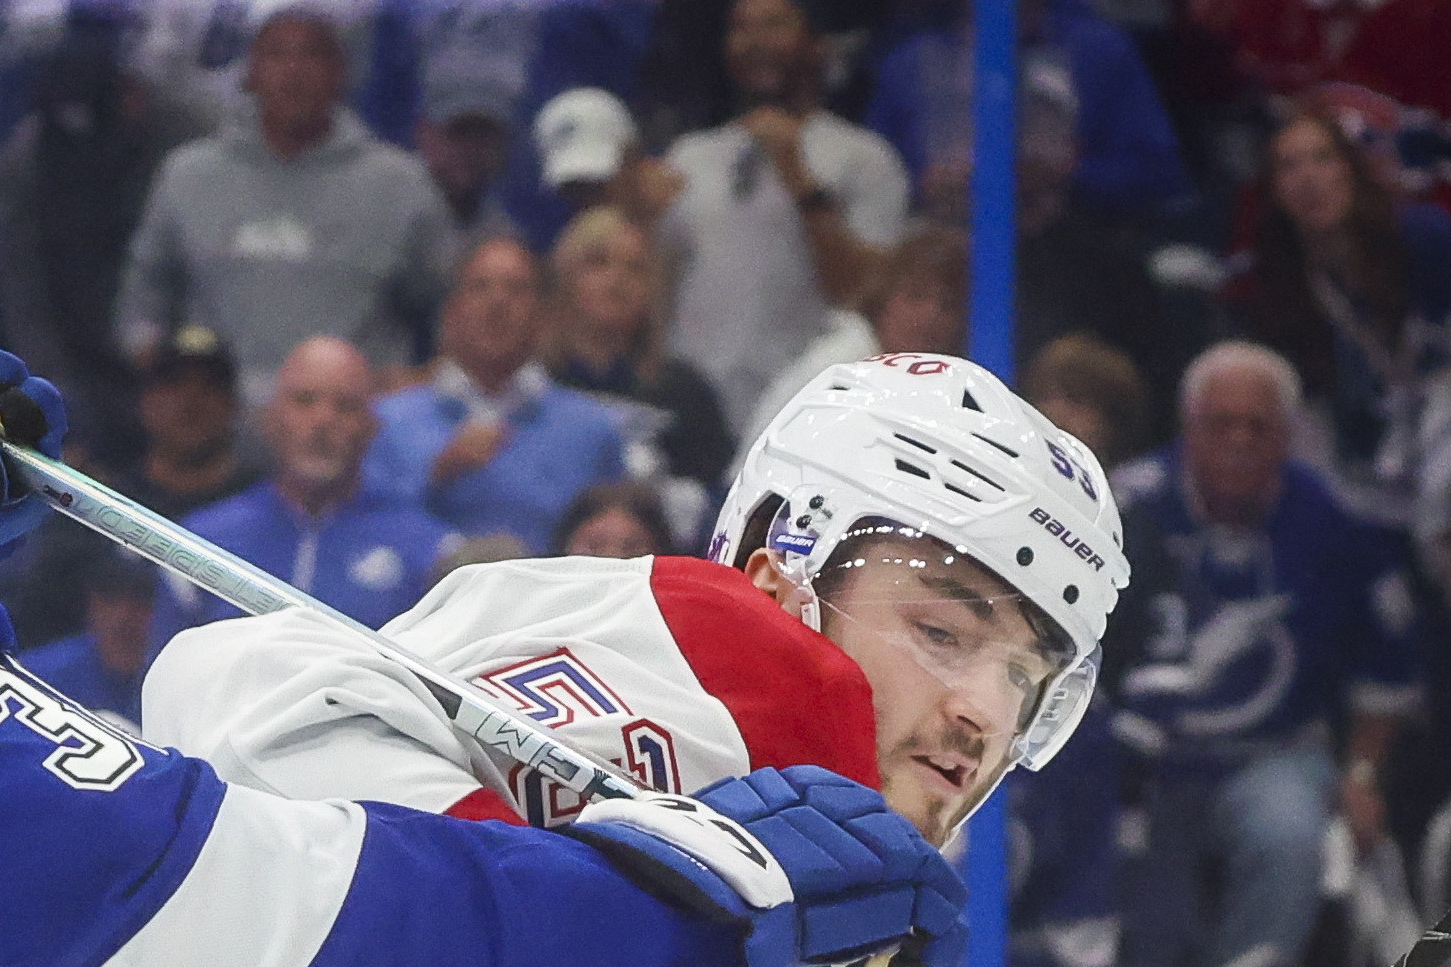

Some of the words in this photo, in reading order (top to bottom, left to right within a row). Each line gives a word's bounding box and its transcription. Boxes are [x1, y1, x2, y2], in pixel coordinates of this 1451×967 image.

[93, 501, 286, 617] ETSPEED
[775, 534, 815, 548] BAUER
[1028, 506, 1106, 572] BAUER
